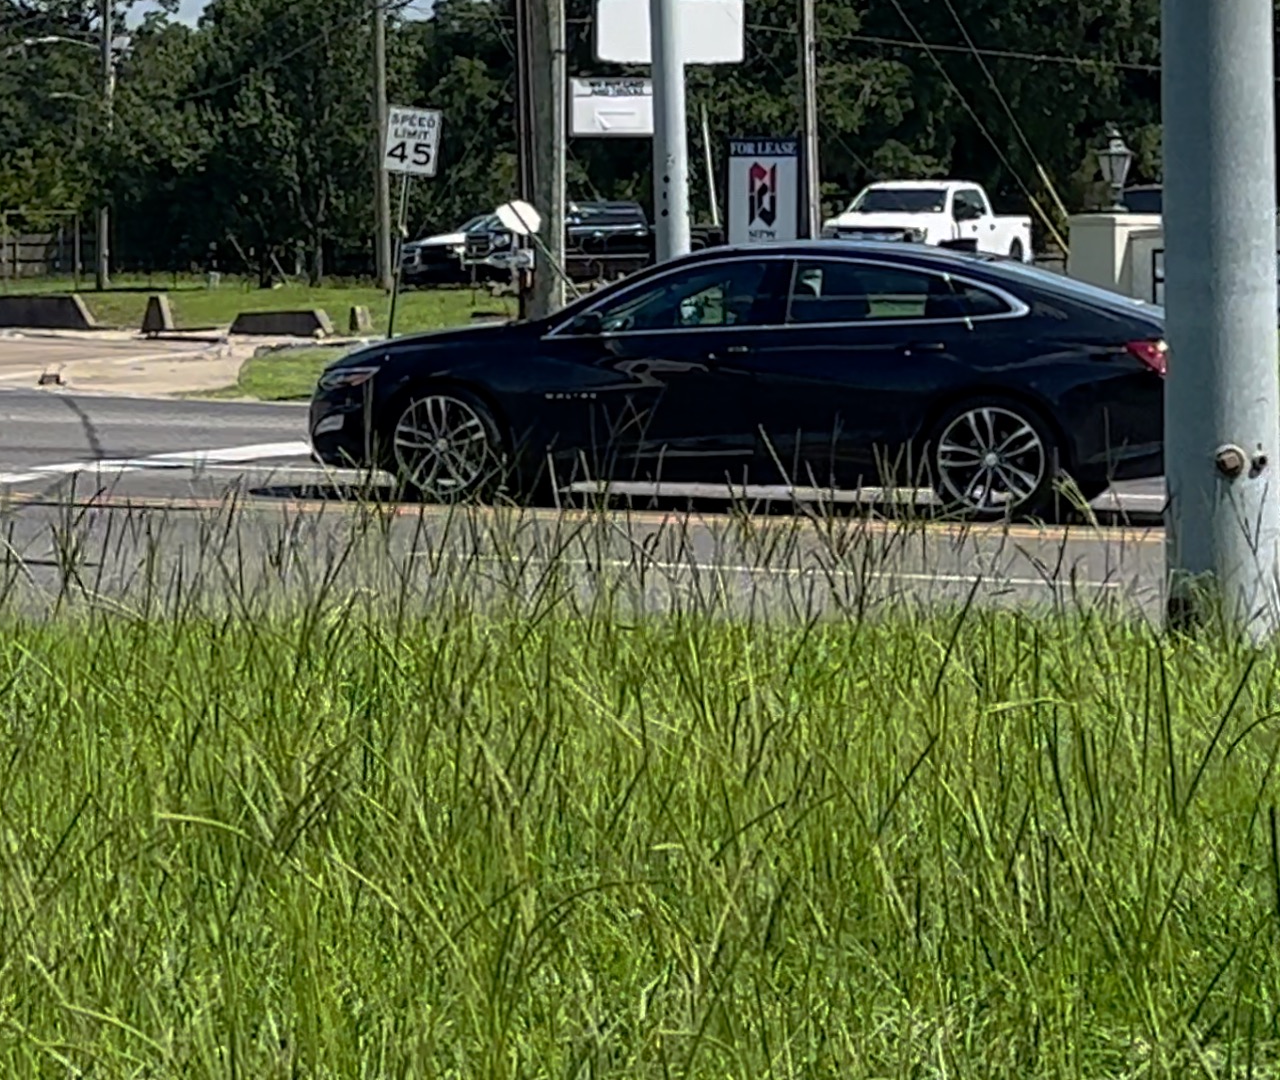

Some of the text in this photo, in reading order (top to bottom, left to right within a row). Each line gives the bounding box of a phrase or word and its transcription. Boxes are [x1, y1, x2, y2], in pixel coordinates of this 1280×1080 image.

[391, 112, 436, 129] SPEED
[394, 127, 429, 140] LIMIT
[386, 141, 431, 166] 45
[730, 142, 797, 155] FOR LEASE
